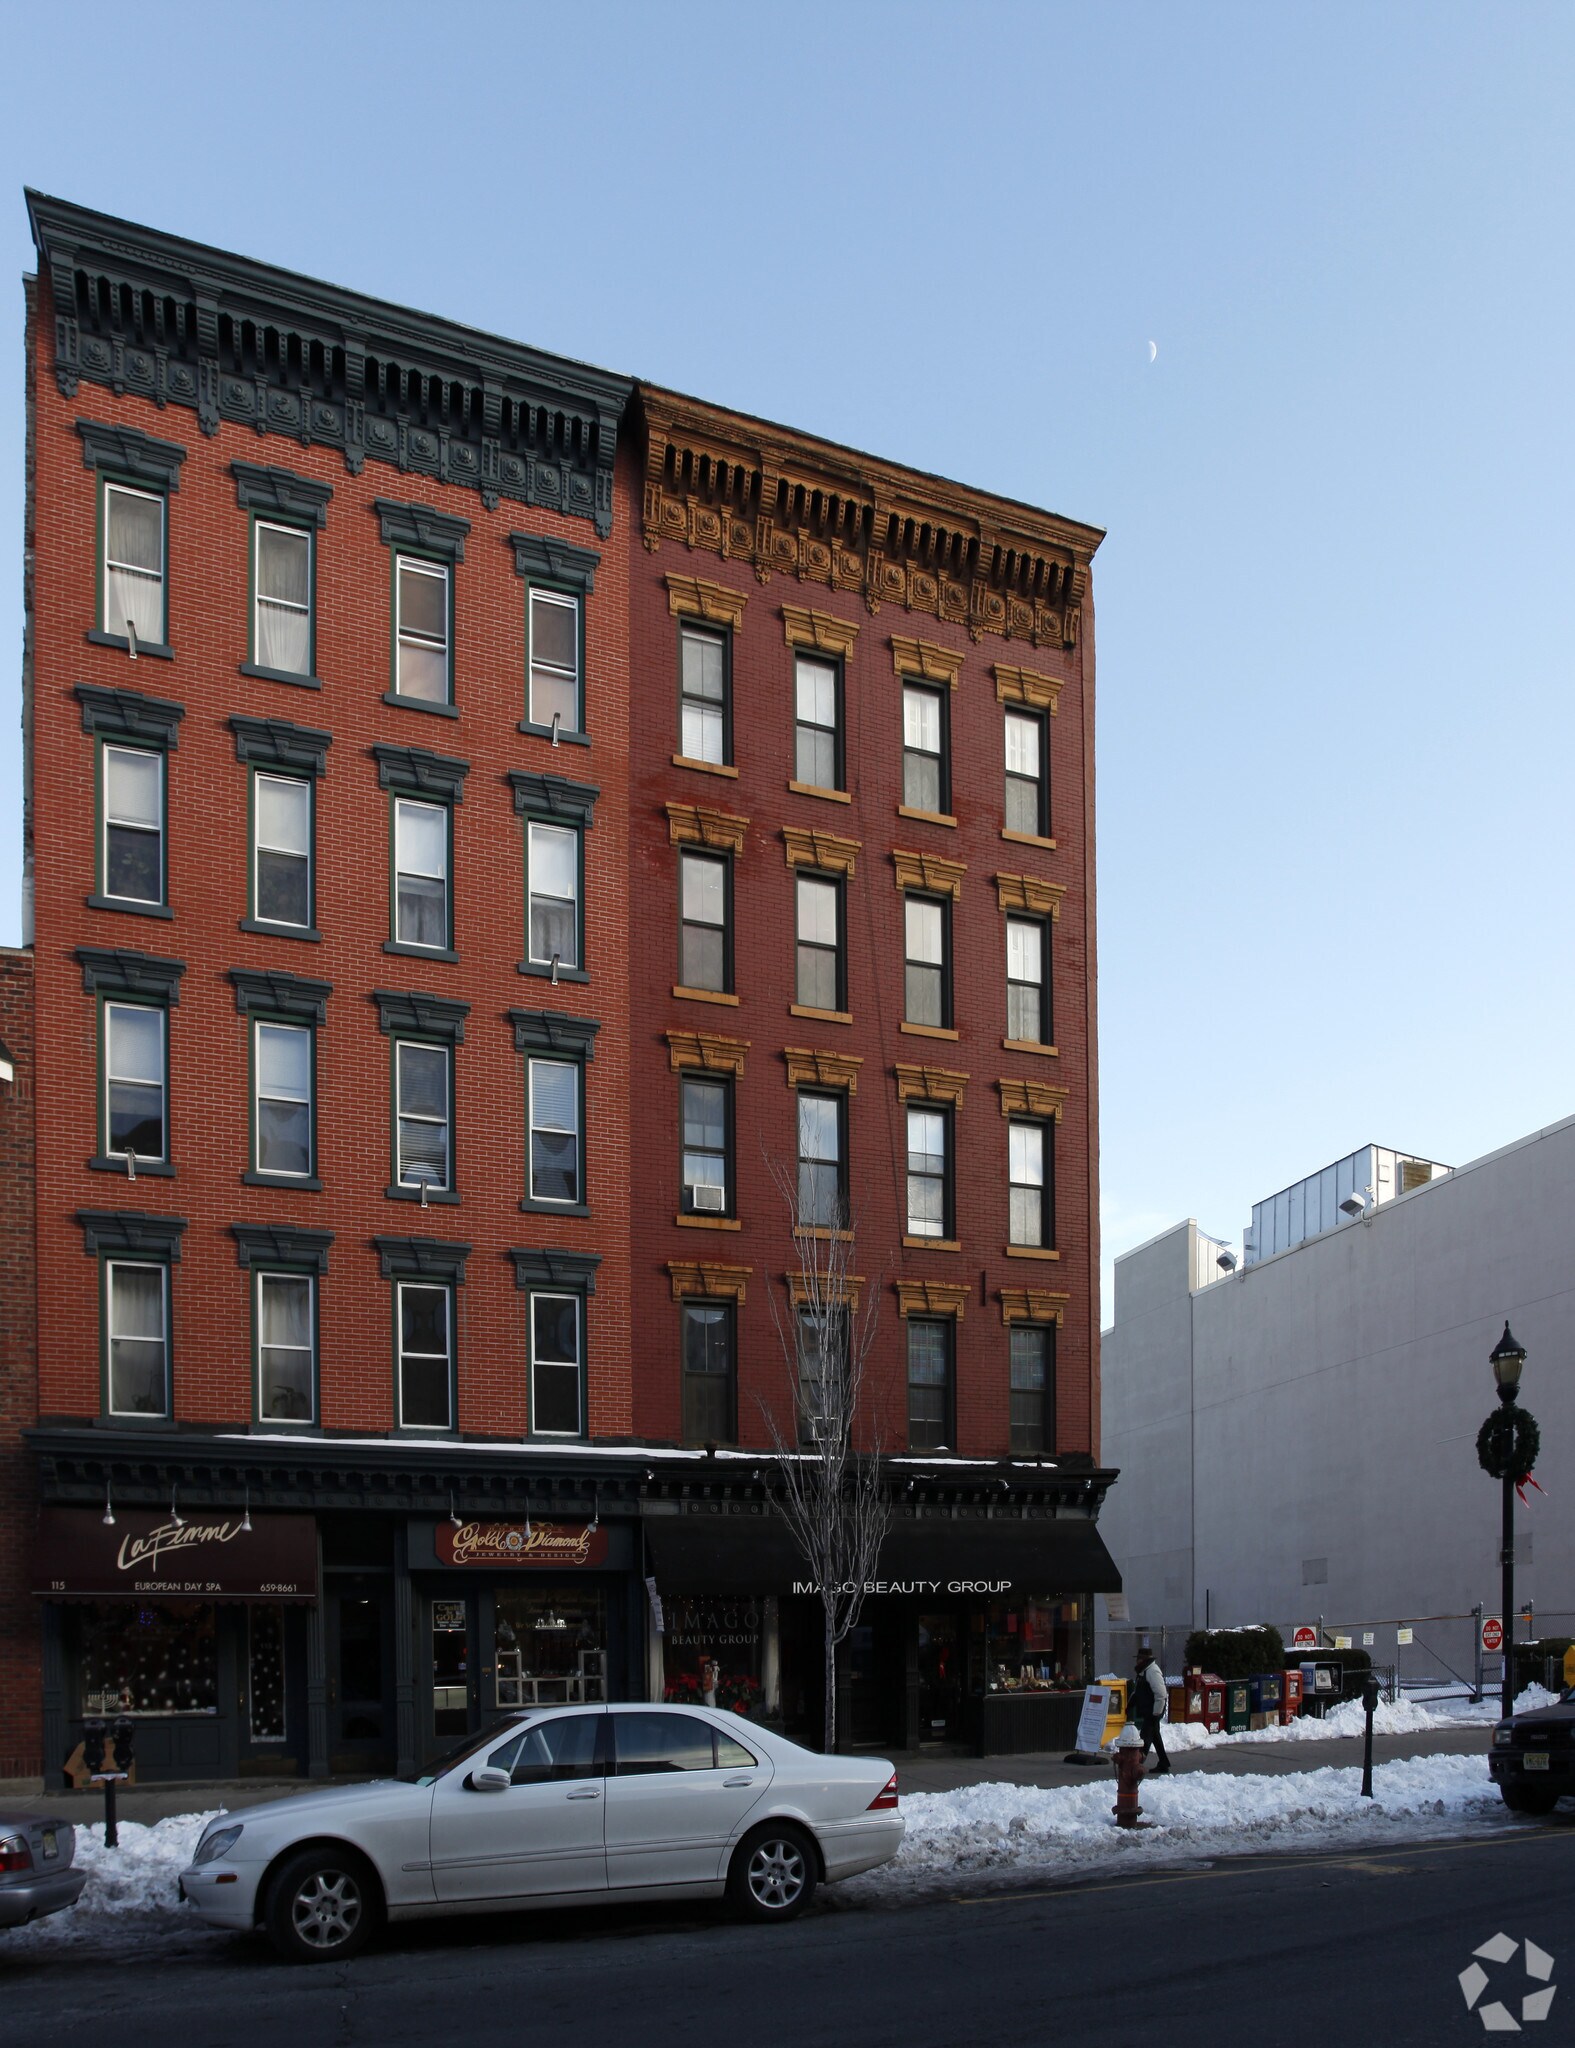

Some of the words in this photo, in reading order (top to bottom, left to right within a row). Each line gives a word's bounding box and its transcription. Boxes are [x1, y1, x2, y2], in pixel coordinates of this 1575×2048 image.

[453, 1522, 507, 1551] Gold
[521, 1529, 591, 1551] Diamond
[51, 1581, 65, 1591] 115
[134, 1581, 181, 1591] EUROPEAN
[184, 1582, 202, 1591] DAY
[205, 1583, 222, 1592] SPA
[863, 1581, 942, 1594] BEAUTY
[947, 1581, 1012, 1593] GROUP
[671, 1611, 760, 1630] IMAGO
[671, 1634, 715, 1645] BEAUTY
[718, 1634, 760, 1645] GROUP
[1230, 1724, 1247, 1732] metro
